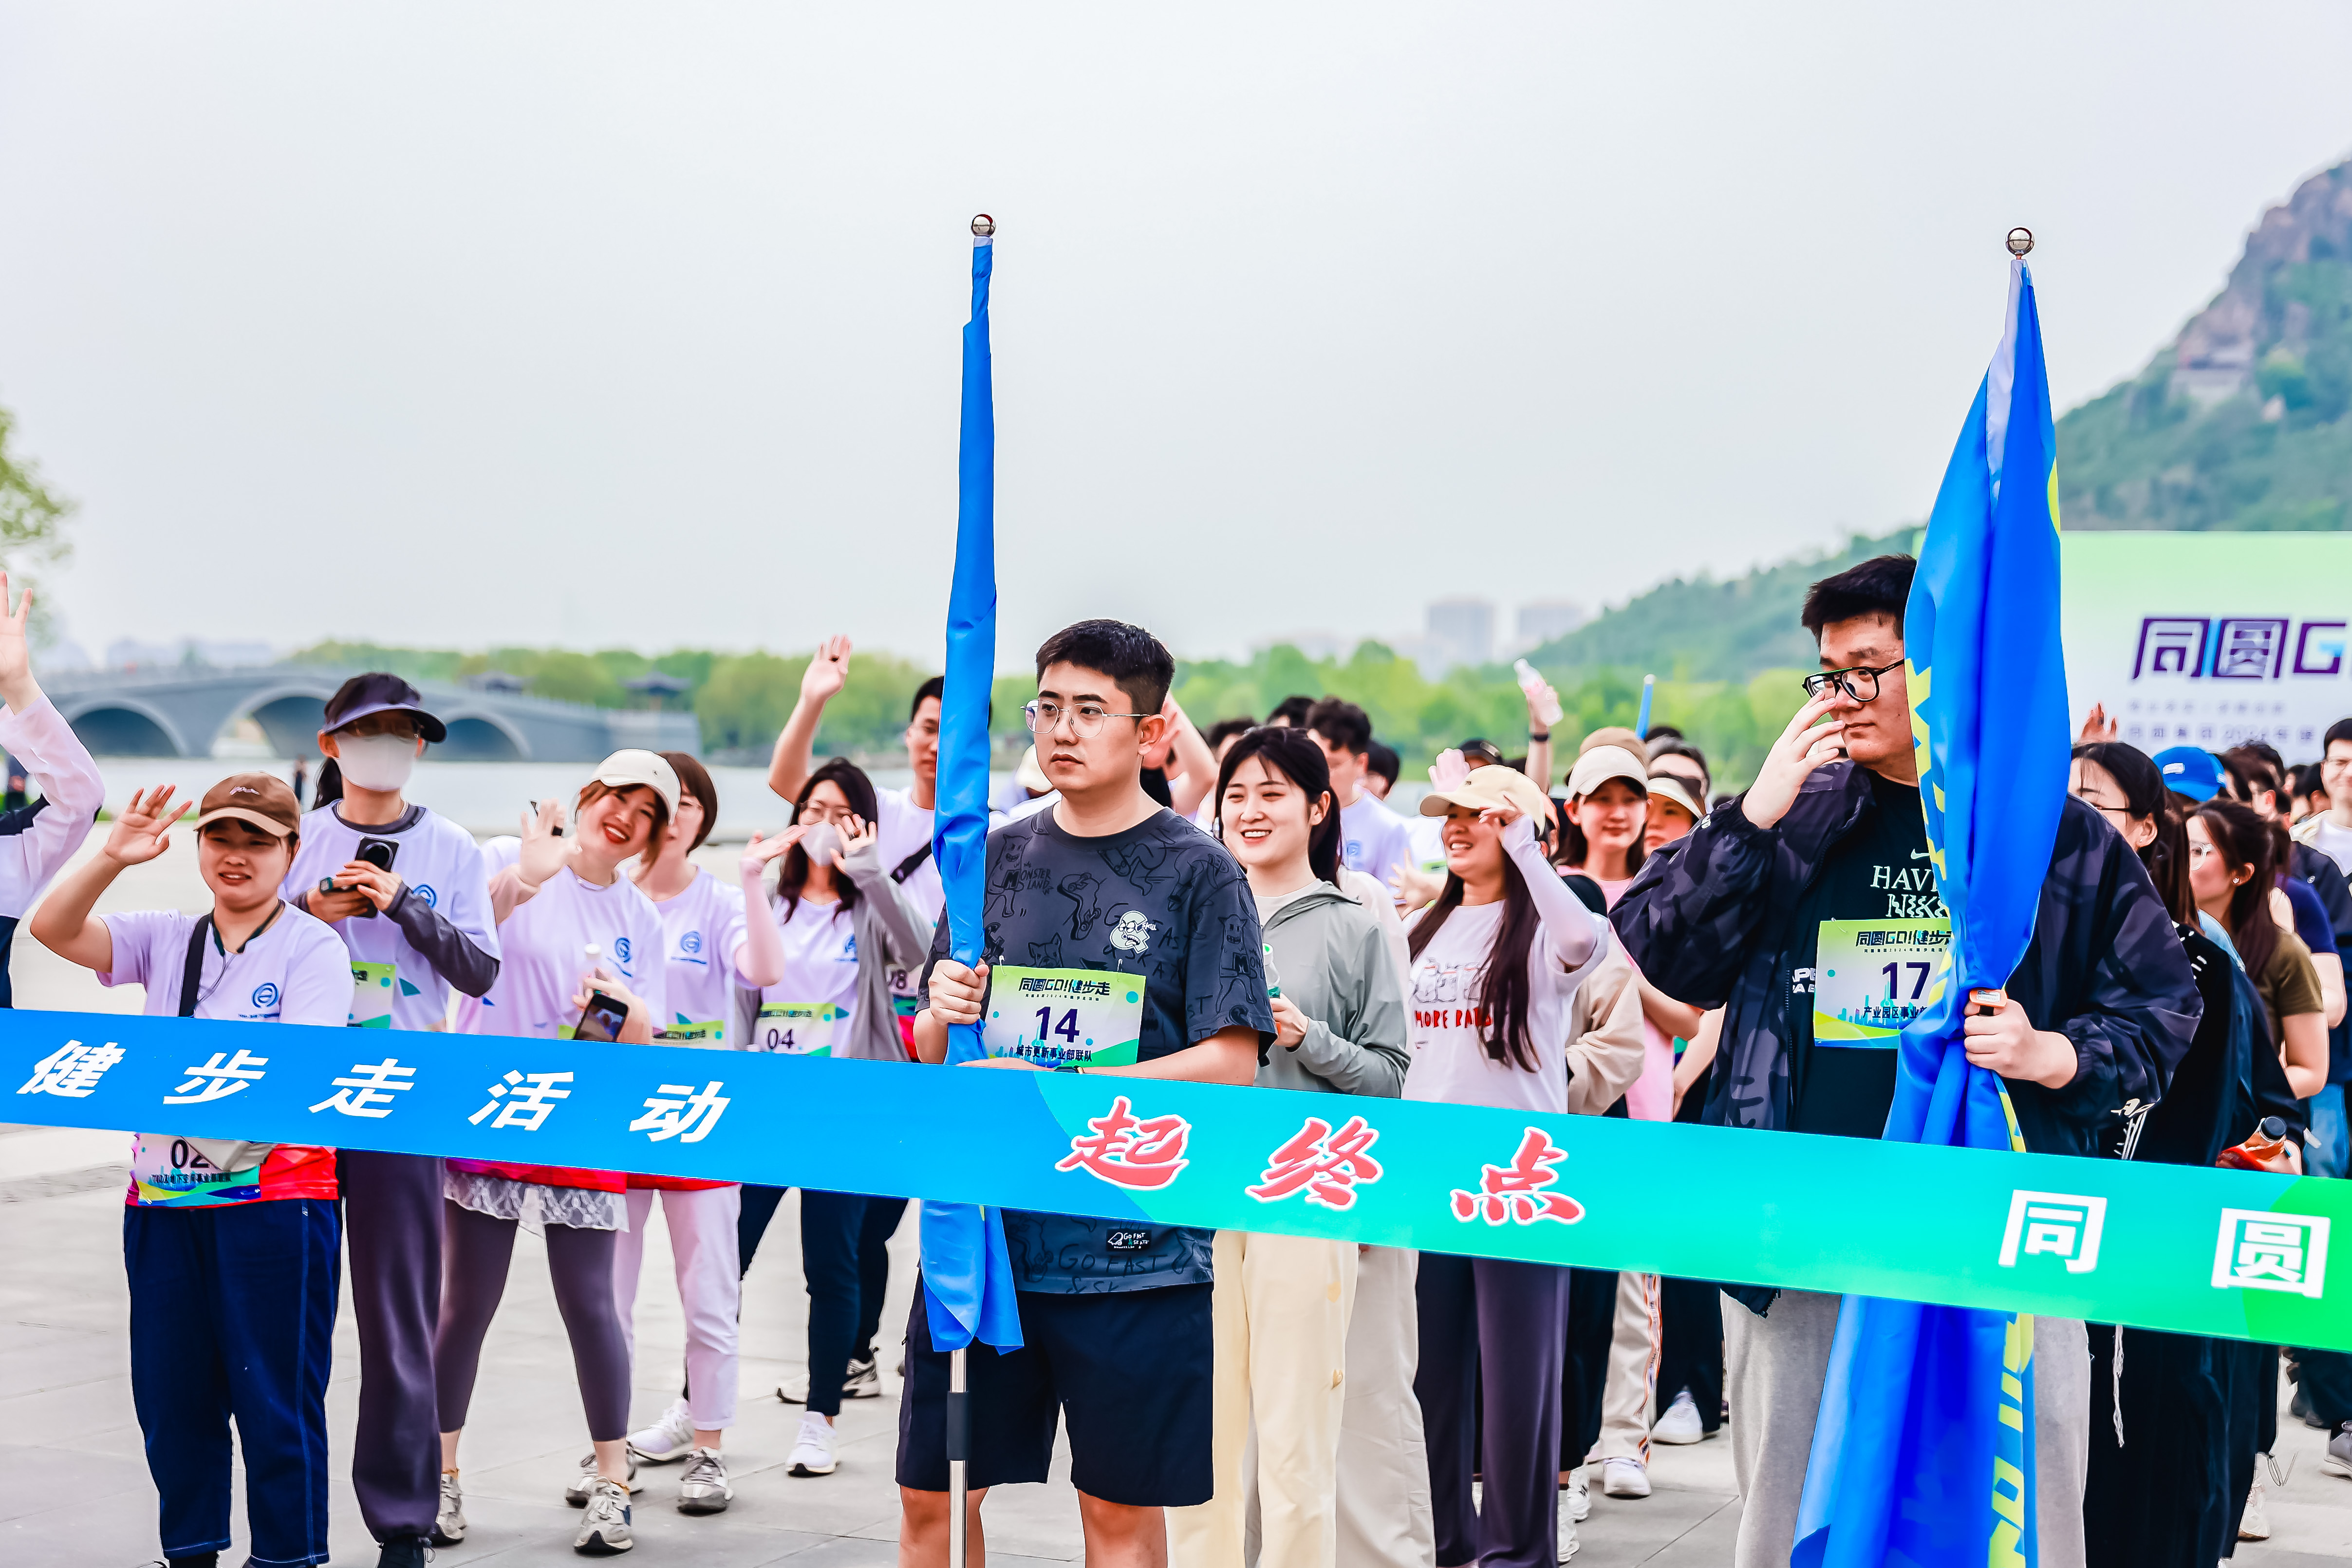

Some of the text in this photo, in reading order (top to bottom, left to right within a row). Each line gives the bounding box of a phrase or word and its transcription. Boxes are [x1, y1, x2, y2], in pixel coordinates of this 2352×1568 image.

[1882, 962, 1931, 1000] 17
[767, 1028, 795, 1050] 04
[1035, 1006, 1080, 1043] 14
[1016, 1044, 1092, 1063] 城市更新事业部联队
[17, 1040, 2330, 1297] 健步走活动 起终点 同圆
